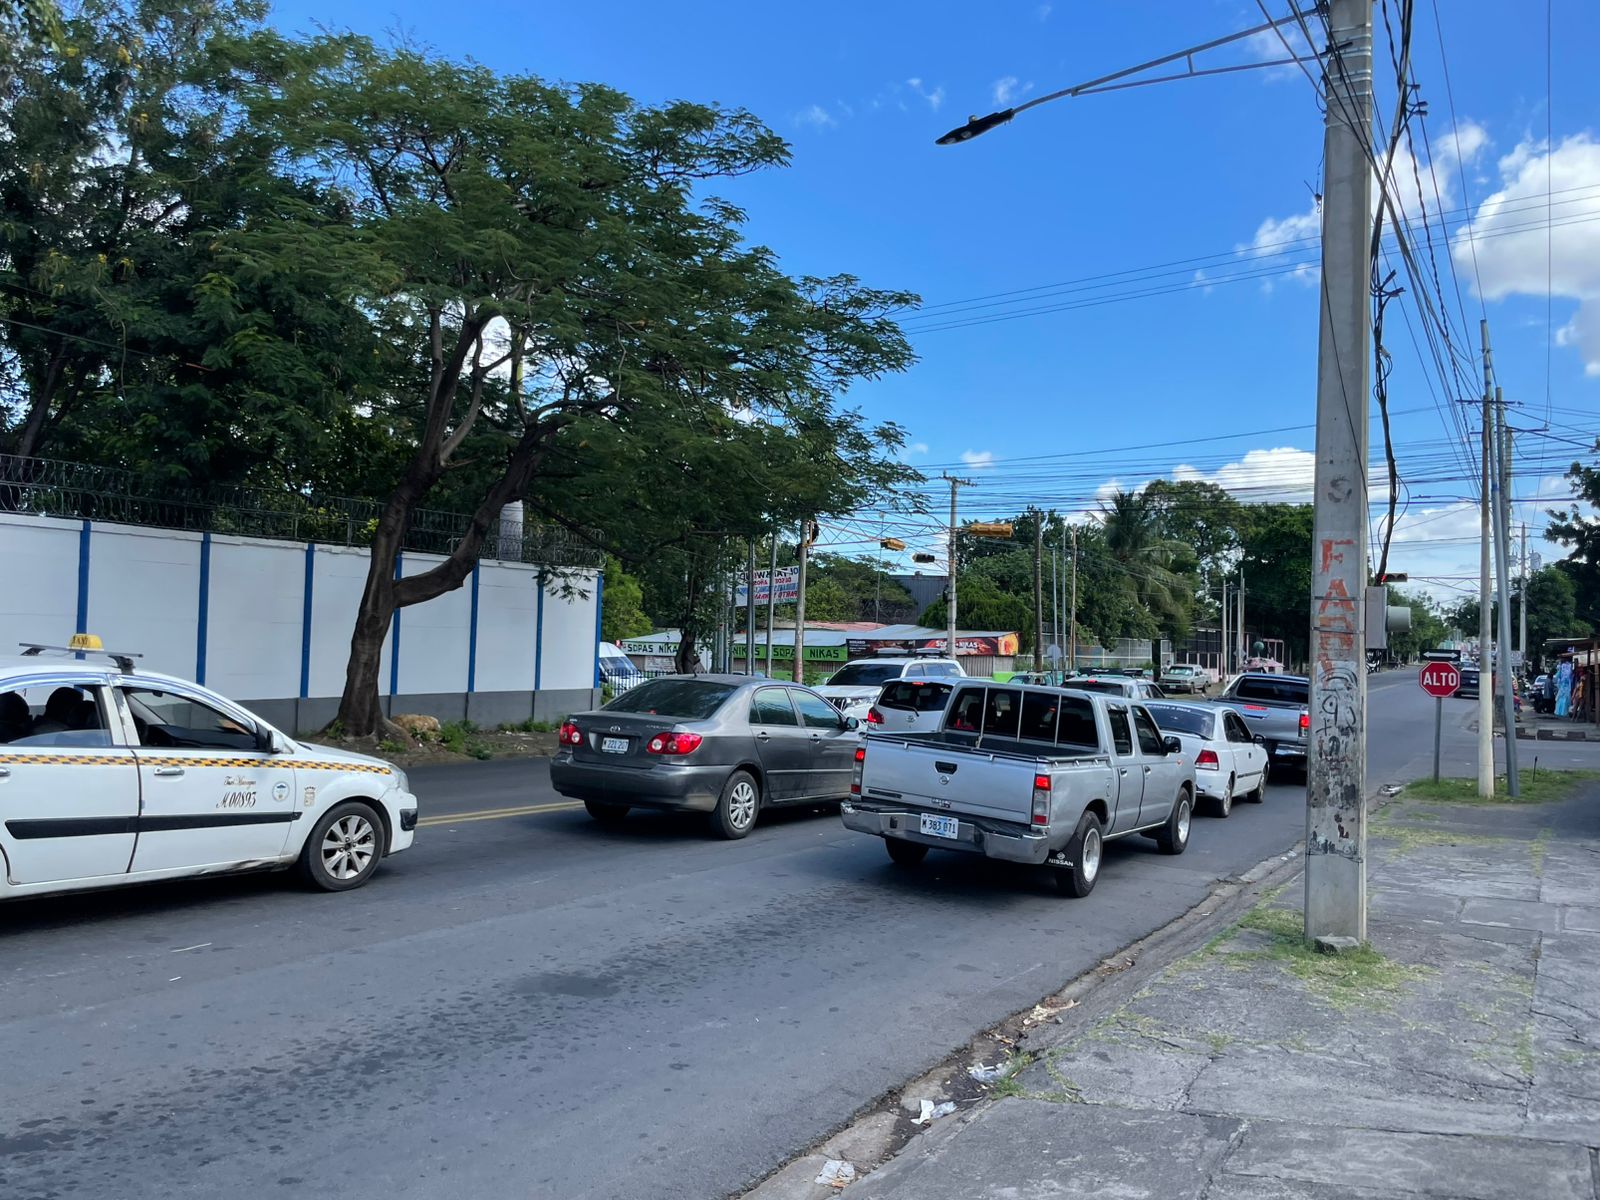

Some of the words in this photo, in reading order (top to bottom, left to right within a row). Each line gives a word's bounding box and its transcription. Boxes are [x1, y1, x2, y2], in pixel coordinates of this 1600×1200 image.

[627, 644, 653, 653] SOPAS
[658, 644, 679, 654] NIKA
[773, 648, 795, 657] SOPA
[809, 649, 839, 659] NIKAS
[1423, 671, 1457, 686] ALTO
[921, 818, 927, 829] M
[928, 819, 942, 831] 383
[943, 822, 956, 834] 071
[1048, 858, 1074, 867] NISSAN
